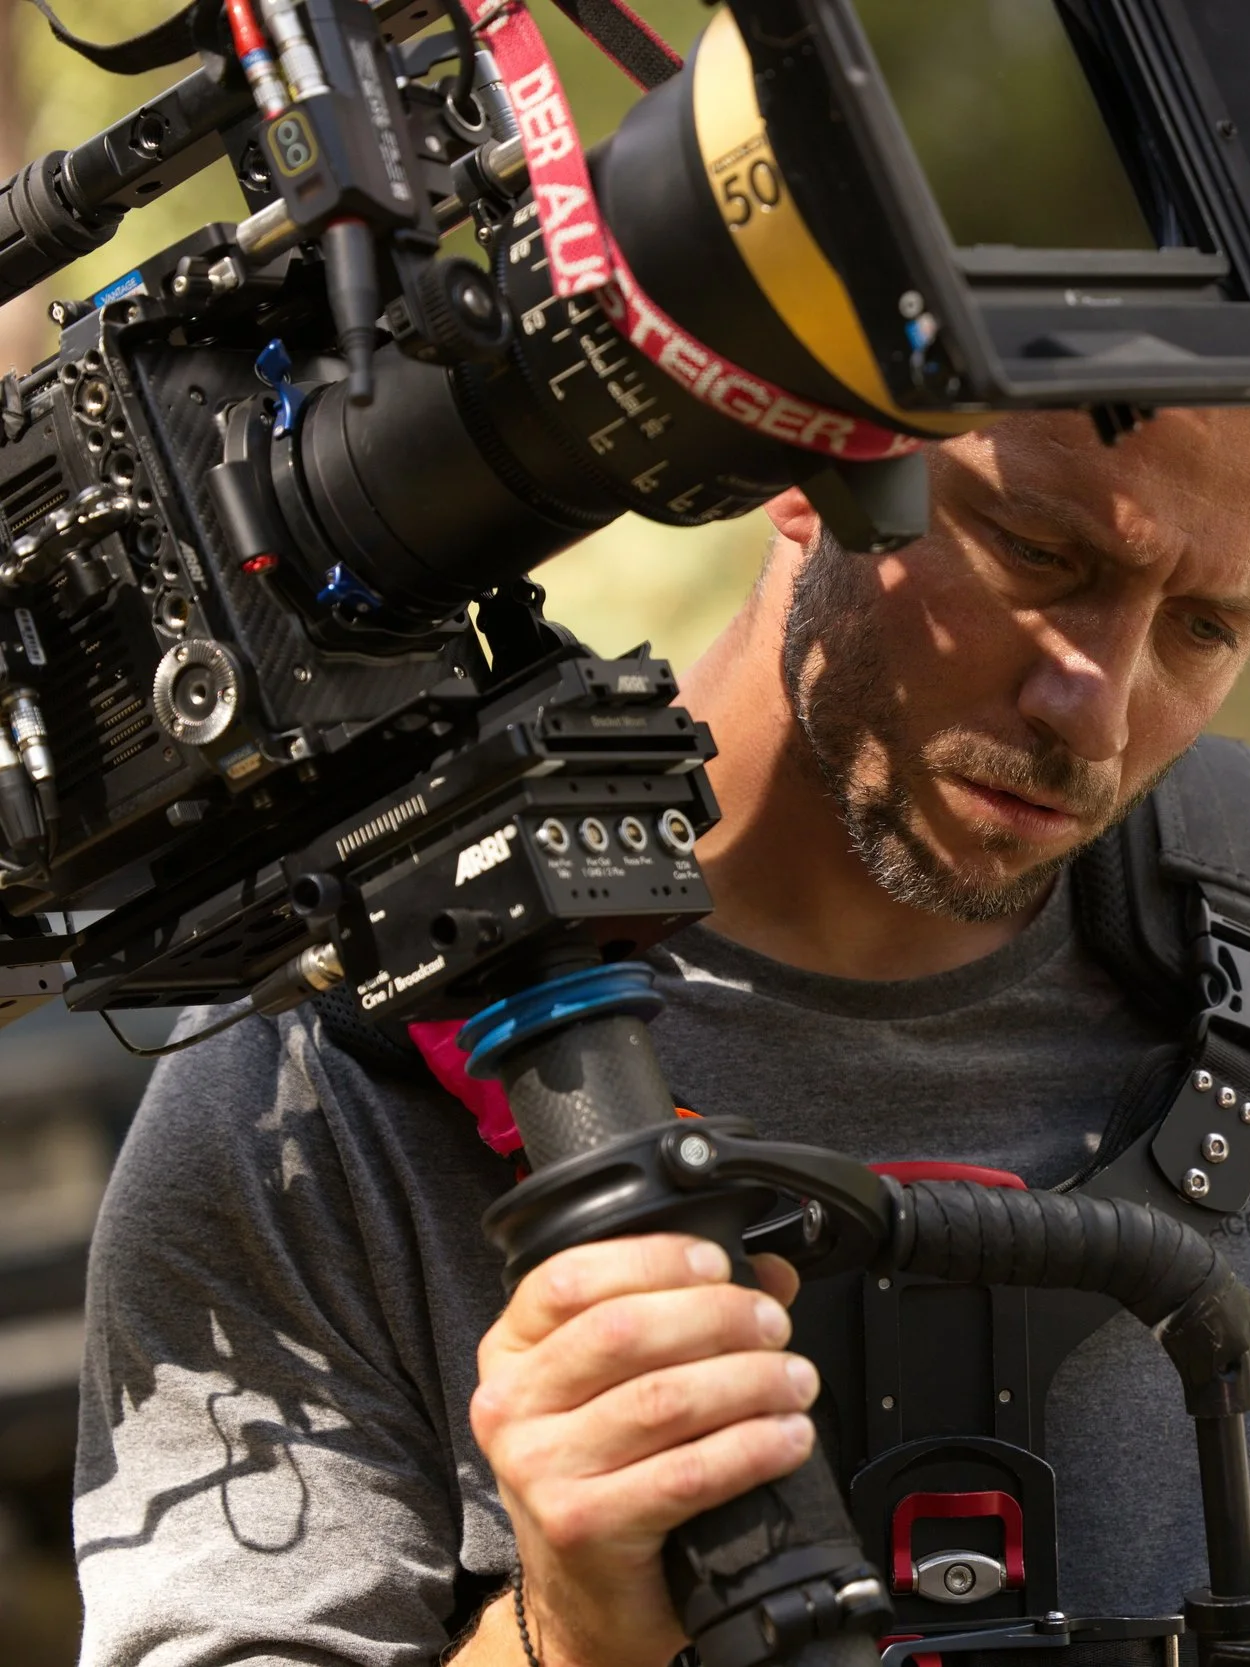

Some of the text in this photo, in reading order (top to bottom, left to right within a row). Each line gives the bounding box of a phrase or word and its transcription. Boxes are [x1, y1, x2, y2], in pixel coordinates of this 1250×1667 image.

[509, 62, 574, 169] DER
[724, 158, 779, 228] 50
[455, 824, 517, 887] ARRI
[362, 990, 388, 1009] Cine
[394, 954, 446, 993] Broadcast
